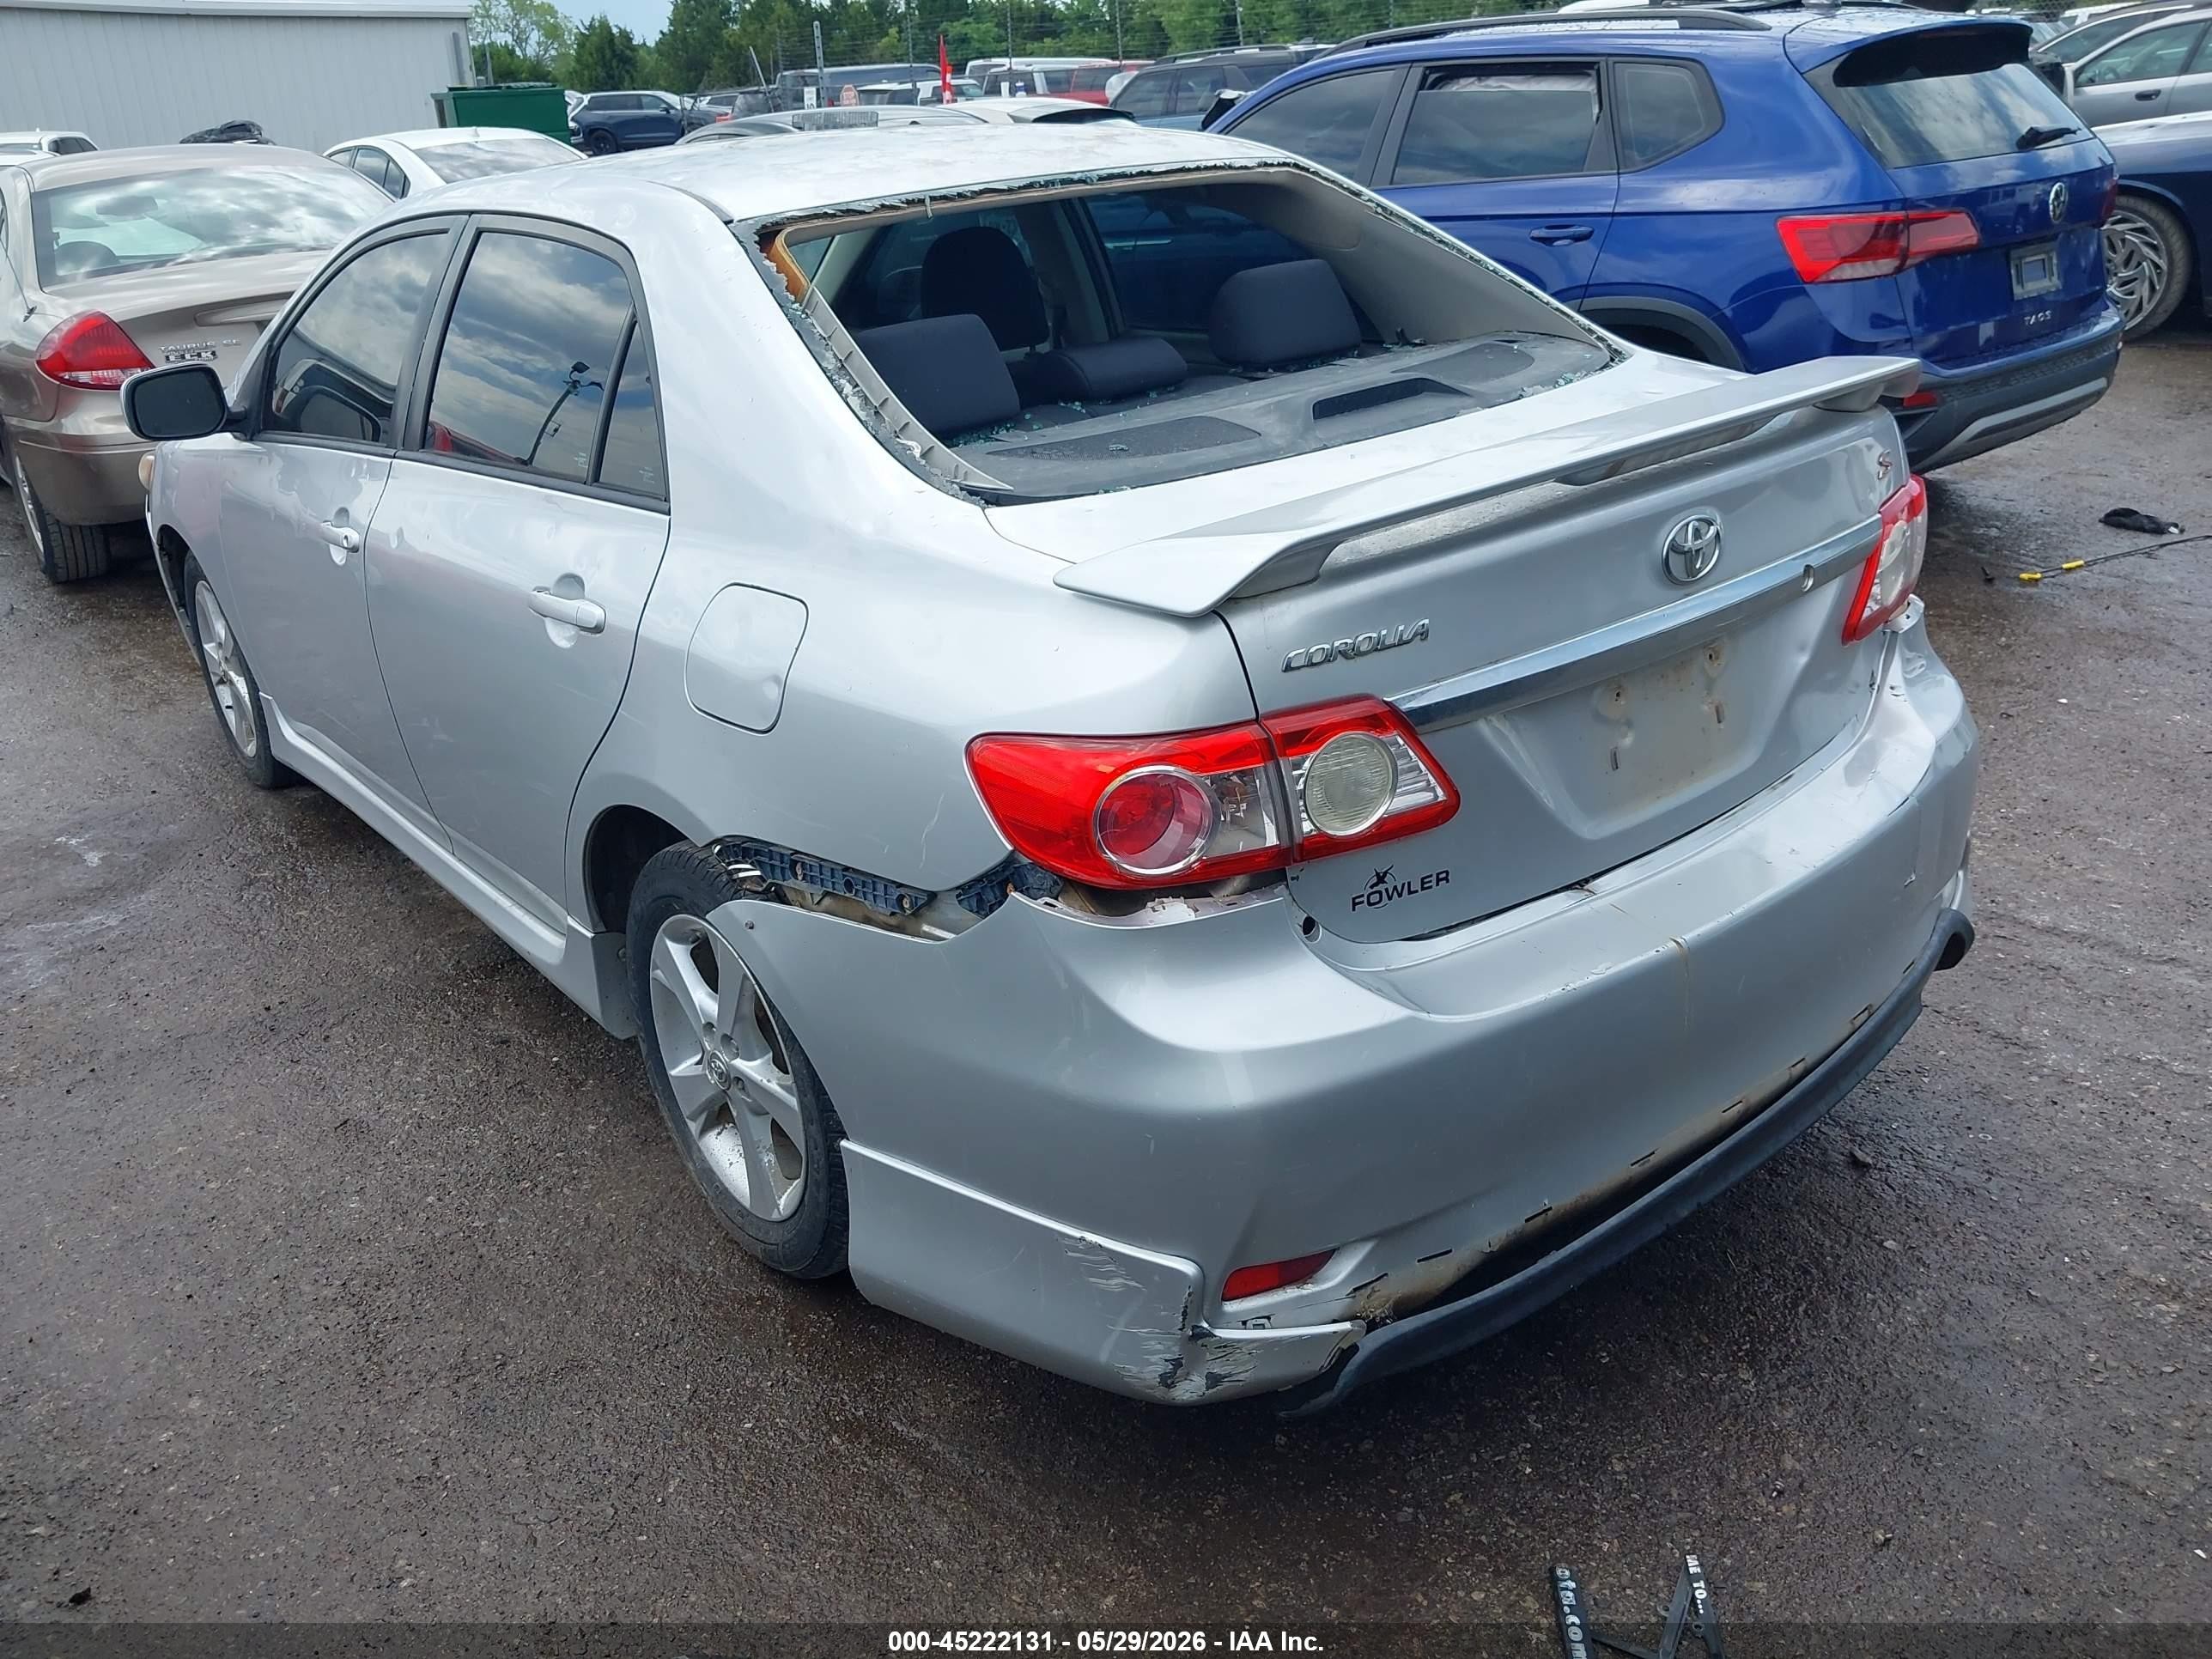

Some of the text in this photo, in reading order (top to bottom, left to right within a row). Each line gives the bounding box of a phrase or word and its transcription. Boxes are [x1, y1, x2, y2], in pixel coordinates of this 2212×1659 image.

[2023, 310, 2052, 325] TAOS
[158, 341, 216, 354] TAURUS
[1877, 448, 1893, 480] S
[1281, 618, 1430, 672] COROLLA
[1351, 869, 1450, 912] FOWLER
